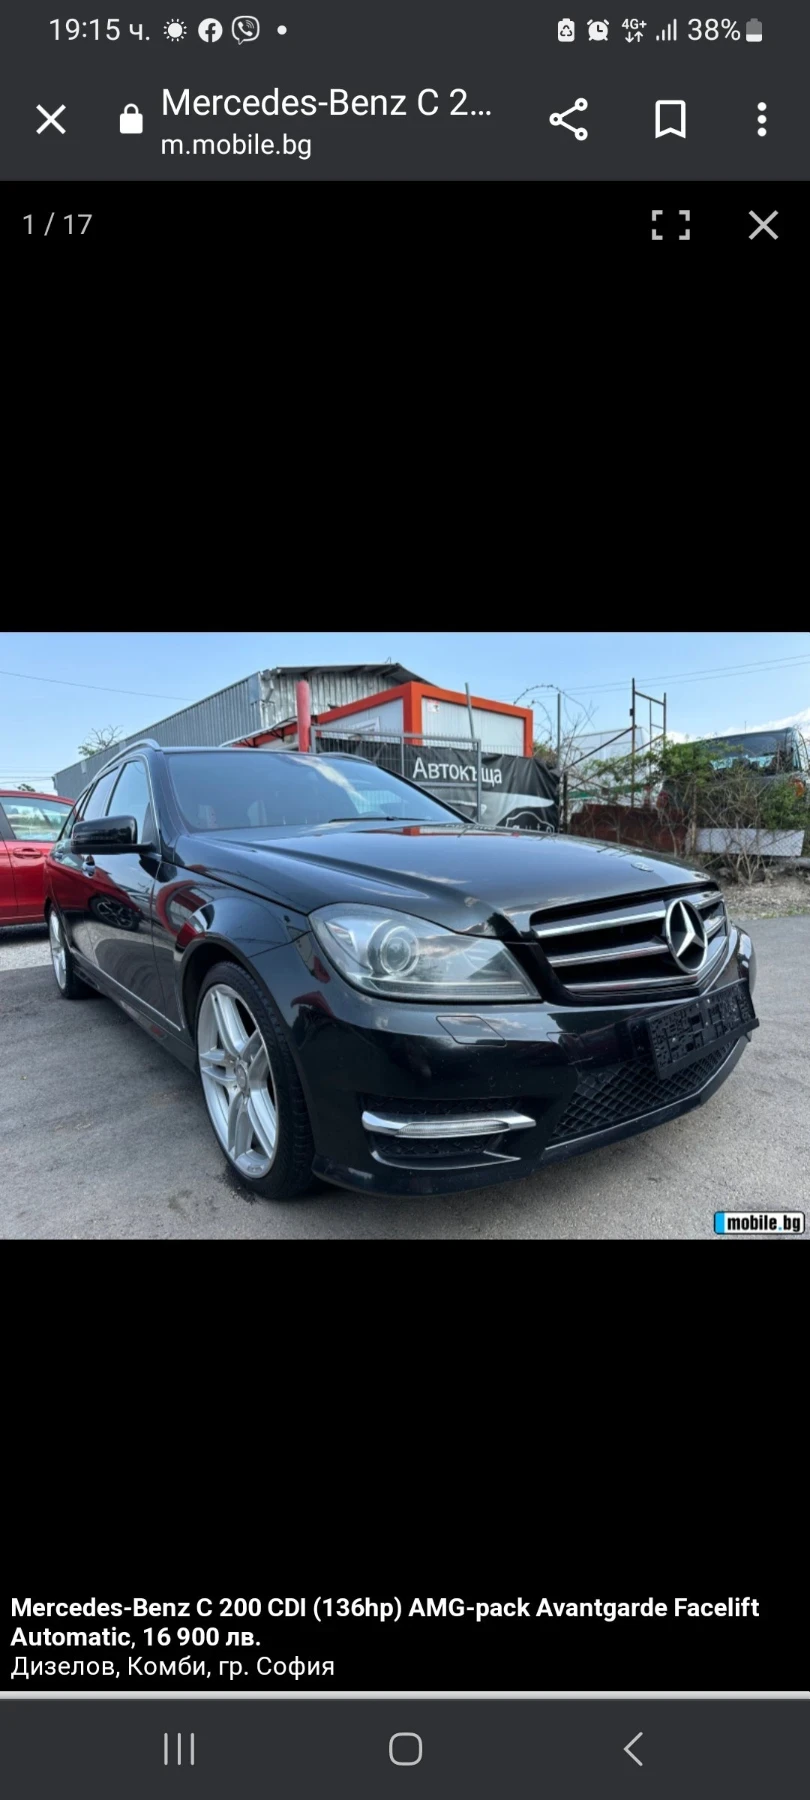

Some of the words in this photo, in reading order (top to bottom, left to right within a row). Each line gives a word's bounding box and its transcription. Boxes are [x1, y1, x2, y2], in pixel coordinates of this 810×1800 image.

[50, 19, 120, 40] 19:15
[130, 24, 149, 40] ч.
[621, 18, 648, 31] 4G+
[688, 18, 740, 41] 38%
[162, 88, 406, 117] Mercedes-Benz
[418, 88, 439, 116] C
[161, 133, 312, 160] m.mobile.bg
[23, 215, 32, 235] 1
[44, 214, 55, 236] /
[63, 215, 93, 235] 17
